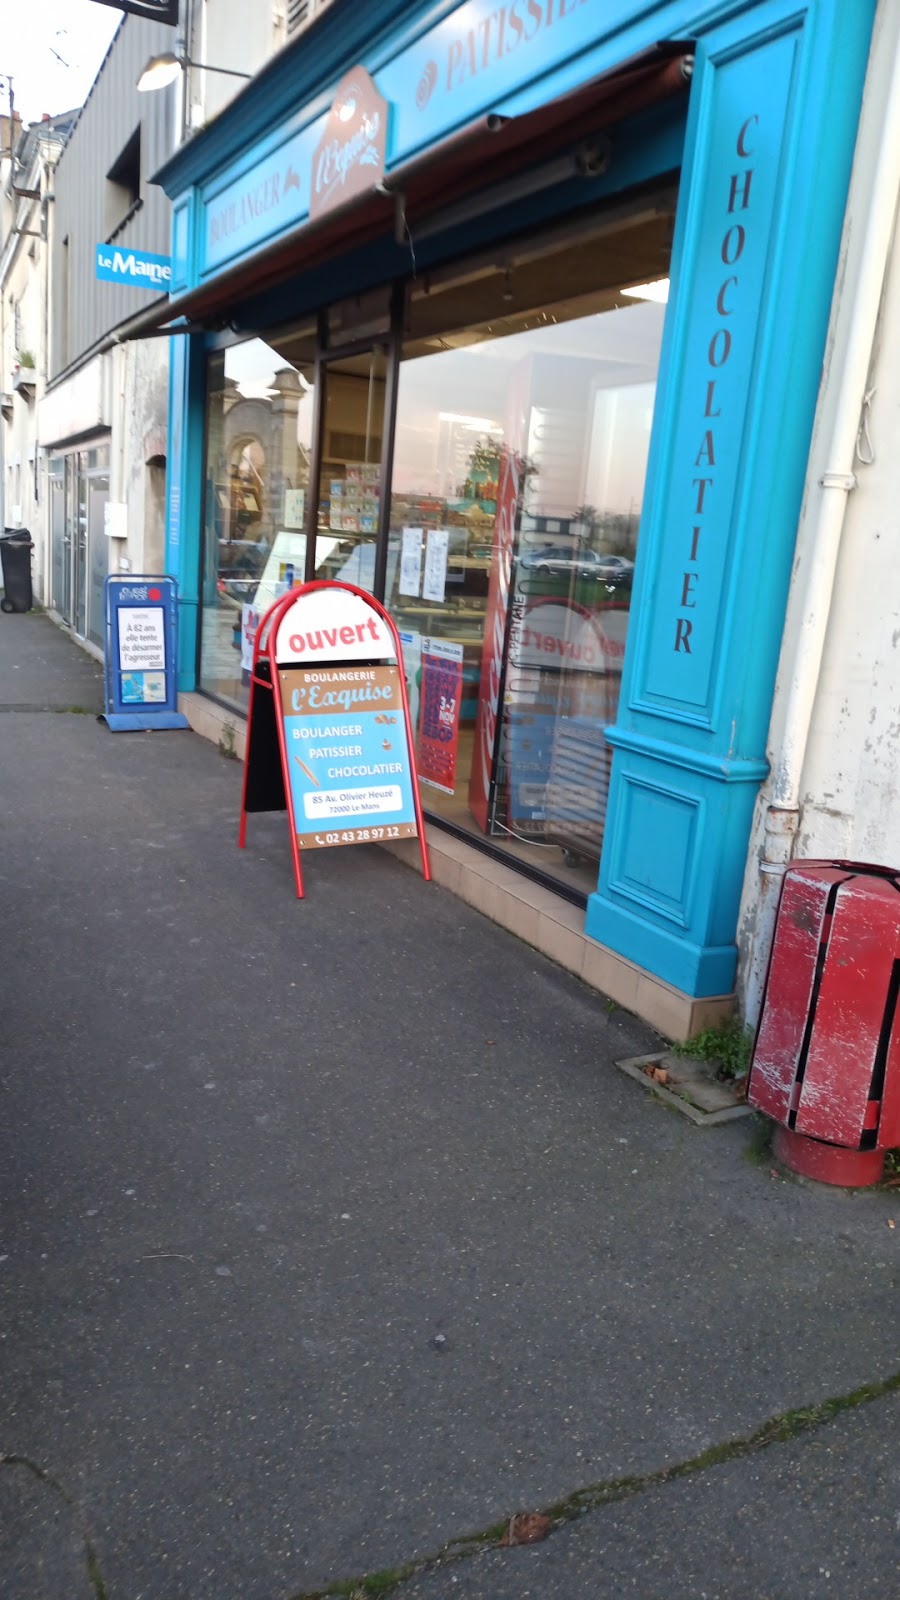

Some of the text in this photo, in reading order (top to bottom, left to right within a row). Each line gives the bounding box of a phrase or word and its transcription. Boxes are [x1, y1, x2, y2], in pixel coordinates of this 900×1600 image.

[208, 170, 280, 249] BOULANGER
[98, 253, 112, 268] Le
[112, 251, 172, 280] Maine
[673, 114, 759, 655] CHOCOLATIER
[134, 624, 142, 632] 82
[289, 617, 380, 653] ouvert
[124, 653, 160, 663] l'agresseur
[304, 671, 376, 683] BOULANGERIE
[291, 682, 393, 711] l'Exquise
[292, 725, 363, 739] BOULANGER
[309, 745, 363, 759] PATISSIER
[327, 762, 403, 779] CHOCOLATIER
[312, 788, 393, 804] 85 Av. Olivier Heuzé
[352, 804, 360, 812] Le
[362, 803, 380, 811] Mans
[326, 826, 399, 844] 02 43 28 97 12
